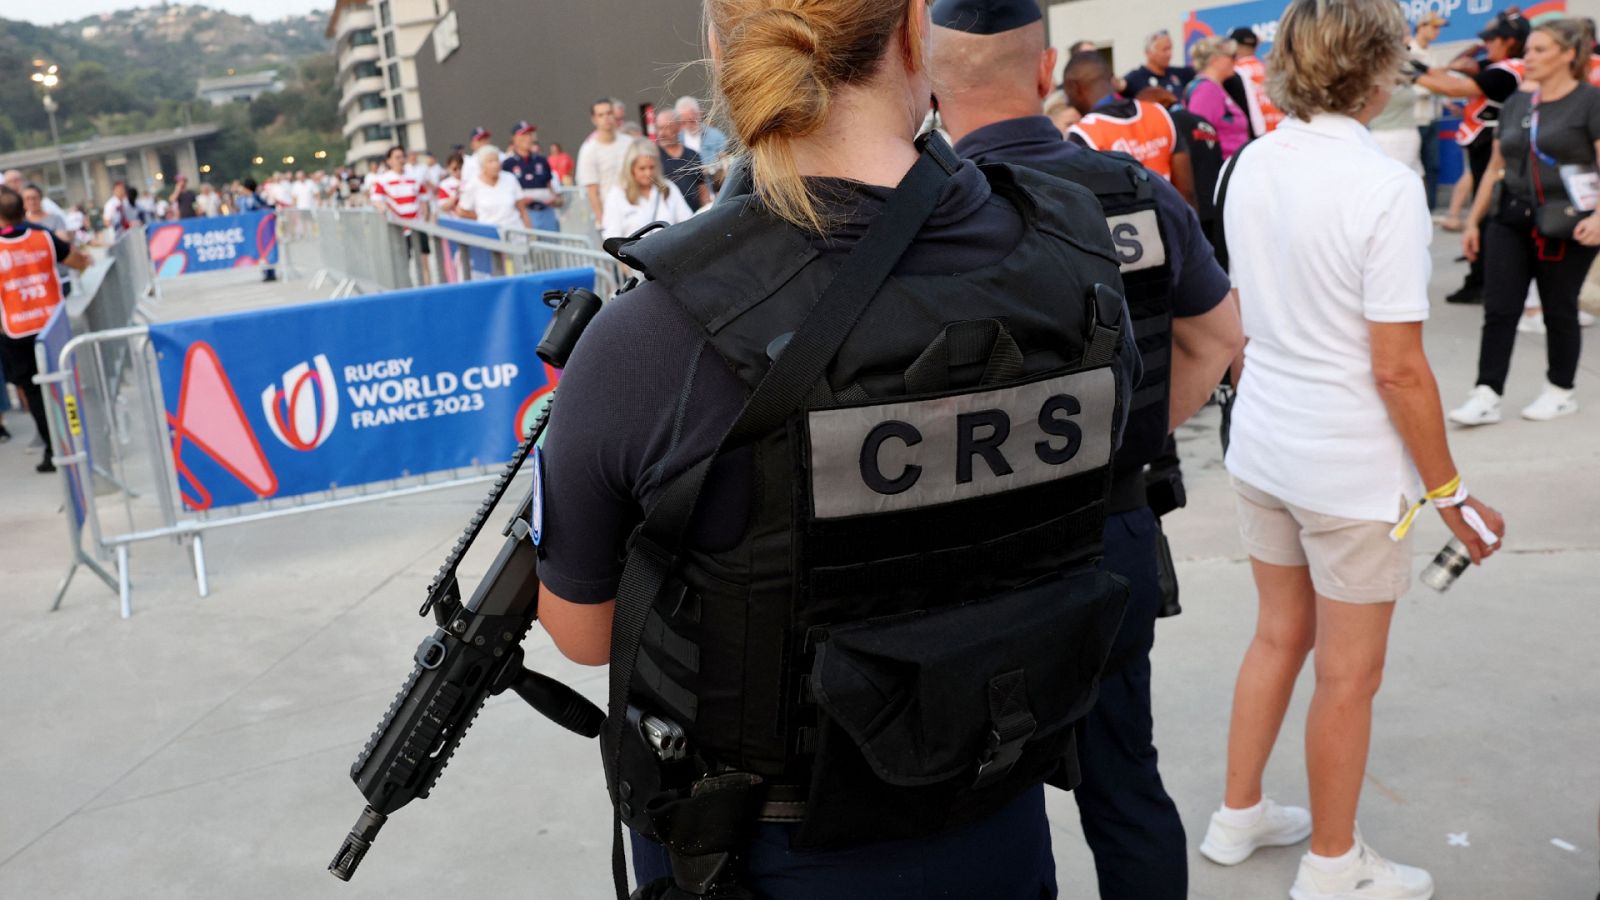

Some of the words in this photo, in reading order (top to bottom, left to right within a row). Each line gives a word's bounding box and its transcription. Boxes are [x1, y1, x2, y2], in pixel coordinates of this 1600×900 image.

[183, 227, 245, 249] FRANCE
[197, 244, 236, 262] 2023
[344, 357, 413, 383] RUGBY
[347, 372, 458, 408] WORLD
[462, 363, 518, 391] CUP
[351, 402, 430, 429] FRANCE
[433, 393, 485, 416] 2023
[859, 393, 1082, 495] CRS
